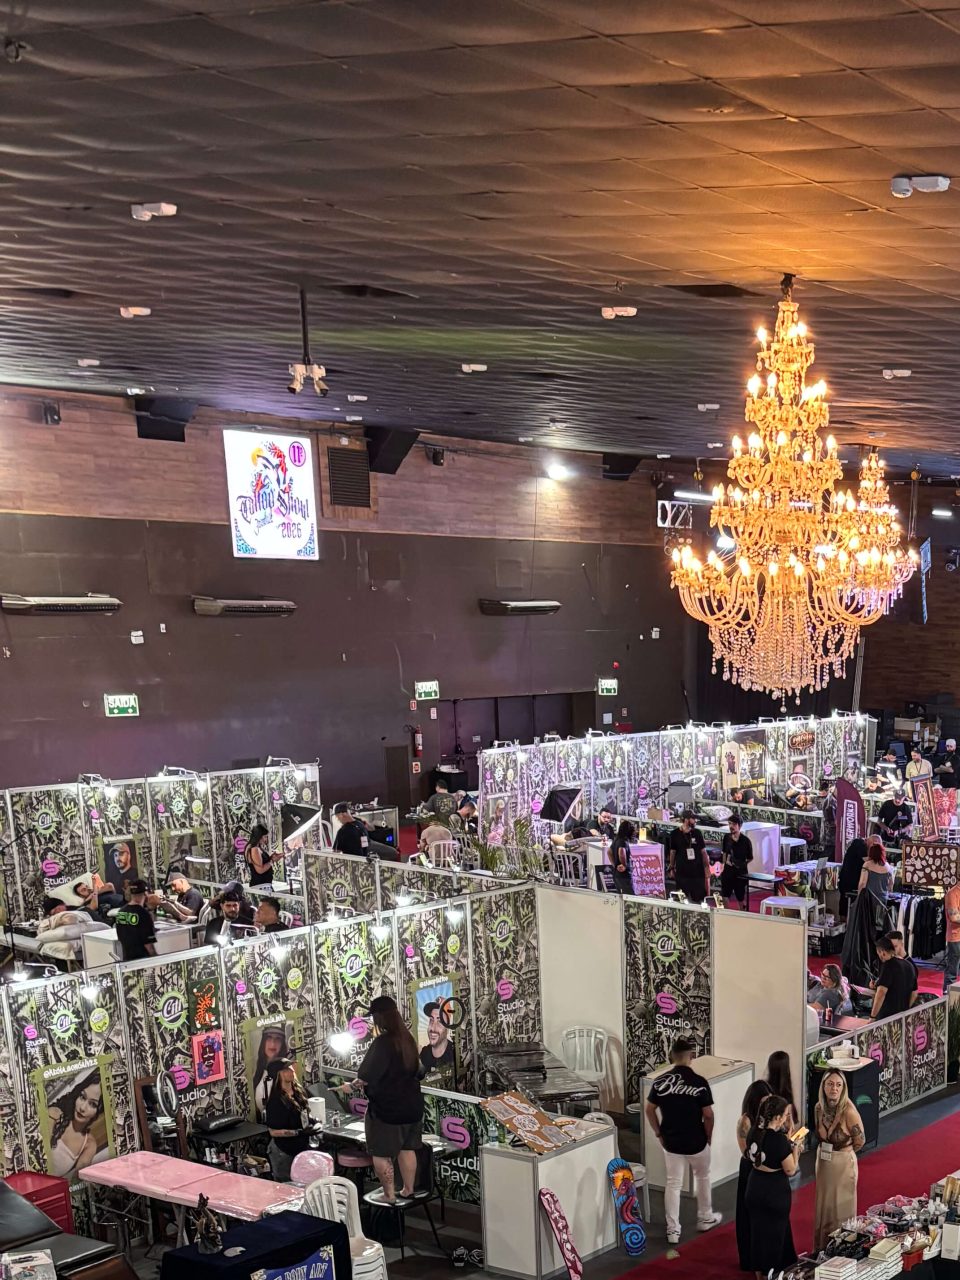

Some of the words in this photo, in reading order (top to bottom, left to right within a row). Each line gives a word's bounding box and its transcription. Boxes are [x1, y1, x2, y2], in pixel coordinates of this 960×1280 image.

[497, 999, 525, 1014] Studio
[498, 1011, 514, 1024] Pay
[656, 1014, 691, 1030] Studio
[656, 1025, 677, 1039] Pay
[913, 1049, 937, 1068] Studio
[913, 1065, 927, 1080] Pay
[440, 1164, 470, 1187] Pay
